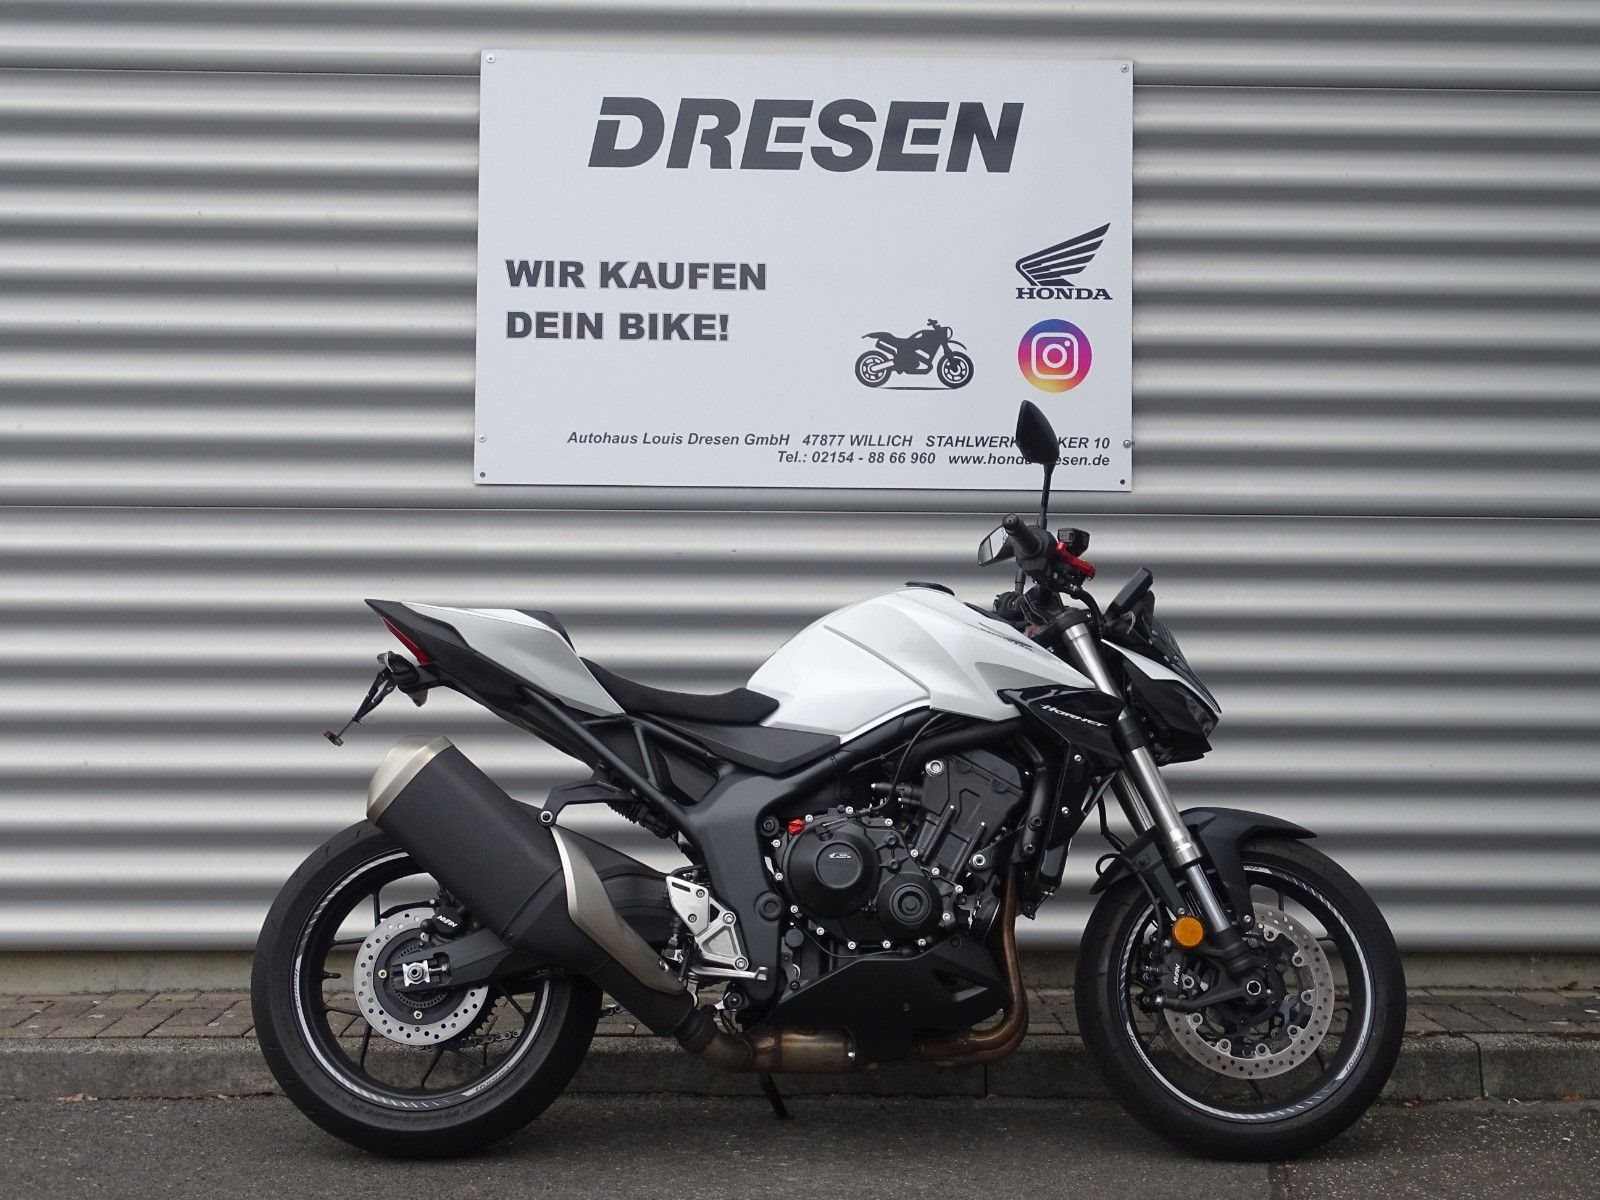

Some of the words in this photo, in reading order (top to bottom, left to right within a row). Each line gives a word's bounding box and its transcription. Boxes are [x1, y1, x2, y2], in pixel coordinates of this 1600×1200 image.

[588, 96, 1024, 173] DRESEN
[506, 260, 585, 289] WIR
[600, 261, 767, 291] KAUFEN
[1015, 287, 1113, 300] HONDA
[506, 311, 604, 341] DEIN
[619, 313, 729, 342] BIKE!
[567, 431, 638, 445] Autohaus
[642, 432, 684, 445] Louis
[687, 432, 740, 446] Dresen
[744, 433, 790, 447] GmbH
[802, 434, 845, 447] 47877
[850, 434, 913, 448] WILLICH
[1094, 437, 1110, 450] 10
[778, 450, 807, 463] Tel.:
[811, 450, 853, 464] 02154
[868, 451, 885, 464] 88
[890, 452, 907, 465] 66
[911, 452, 936, 465] 960
